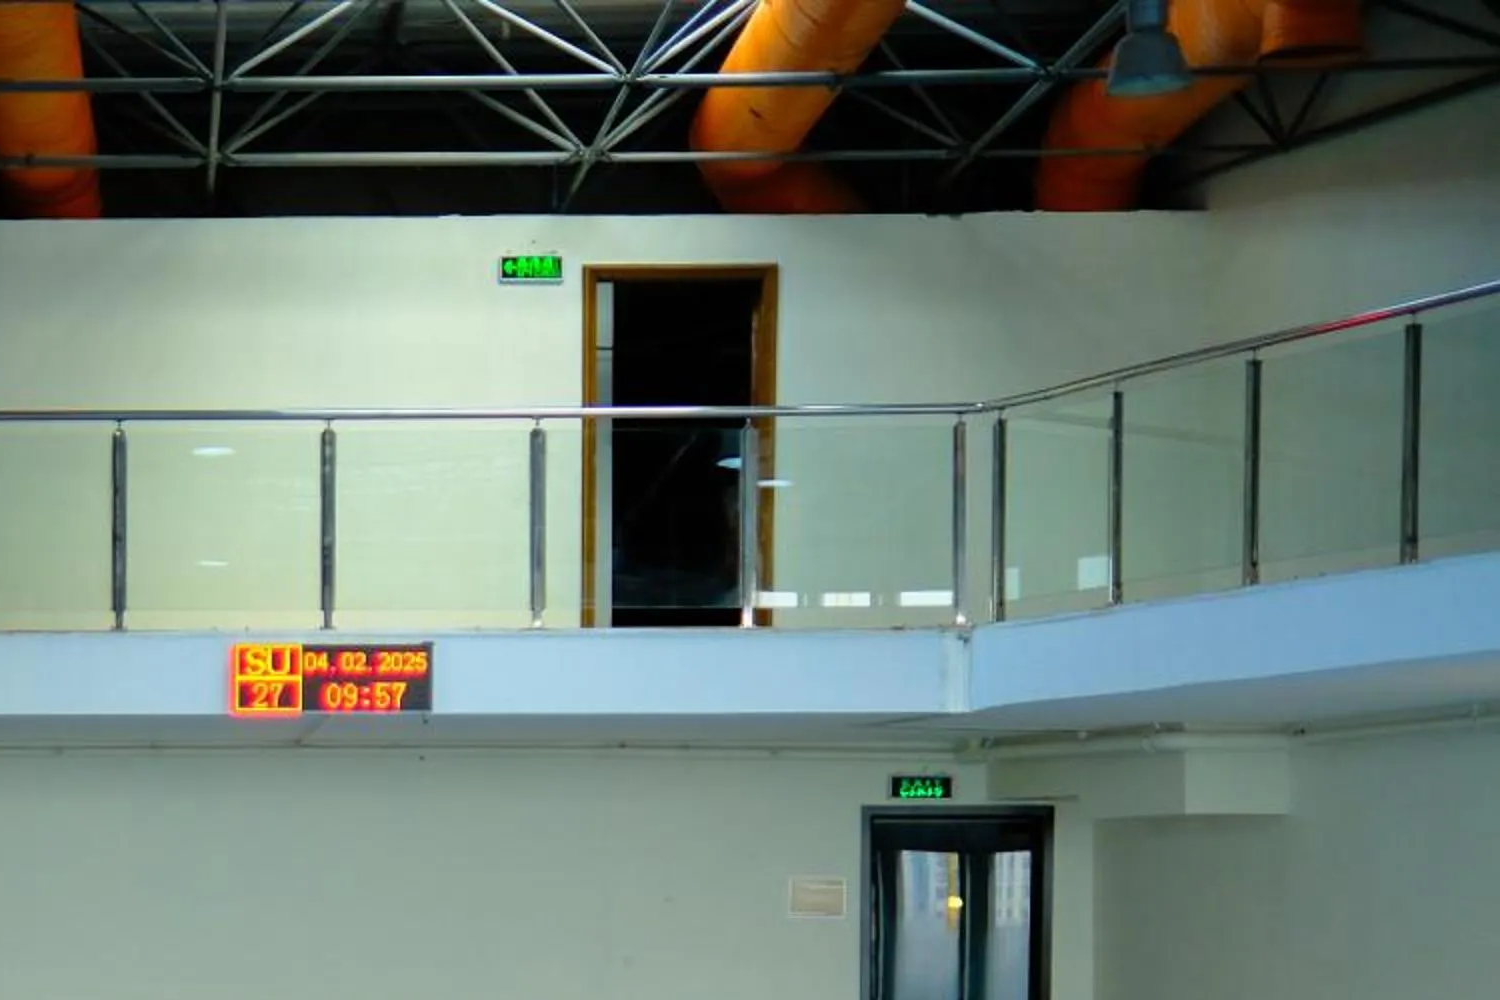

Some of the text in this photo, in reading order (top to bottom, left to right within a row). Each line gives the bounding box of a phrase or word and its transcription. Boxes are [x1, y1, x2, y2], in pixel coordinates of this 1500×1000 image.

[244, 647, 291, 674] SU
[253, 682, 286, 708] 27
[325, 682, 407, 708] 09:57
